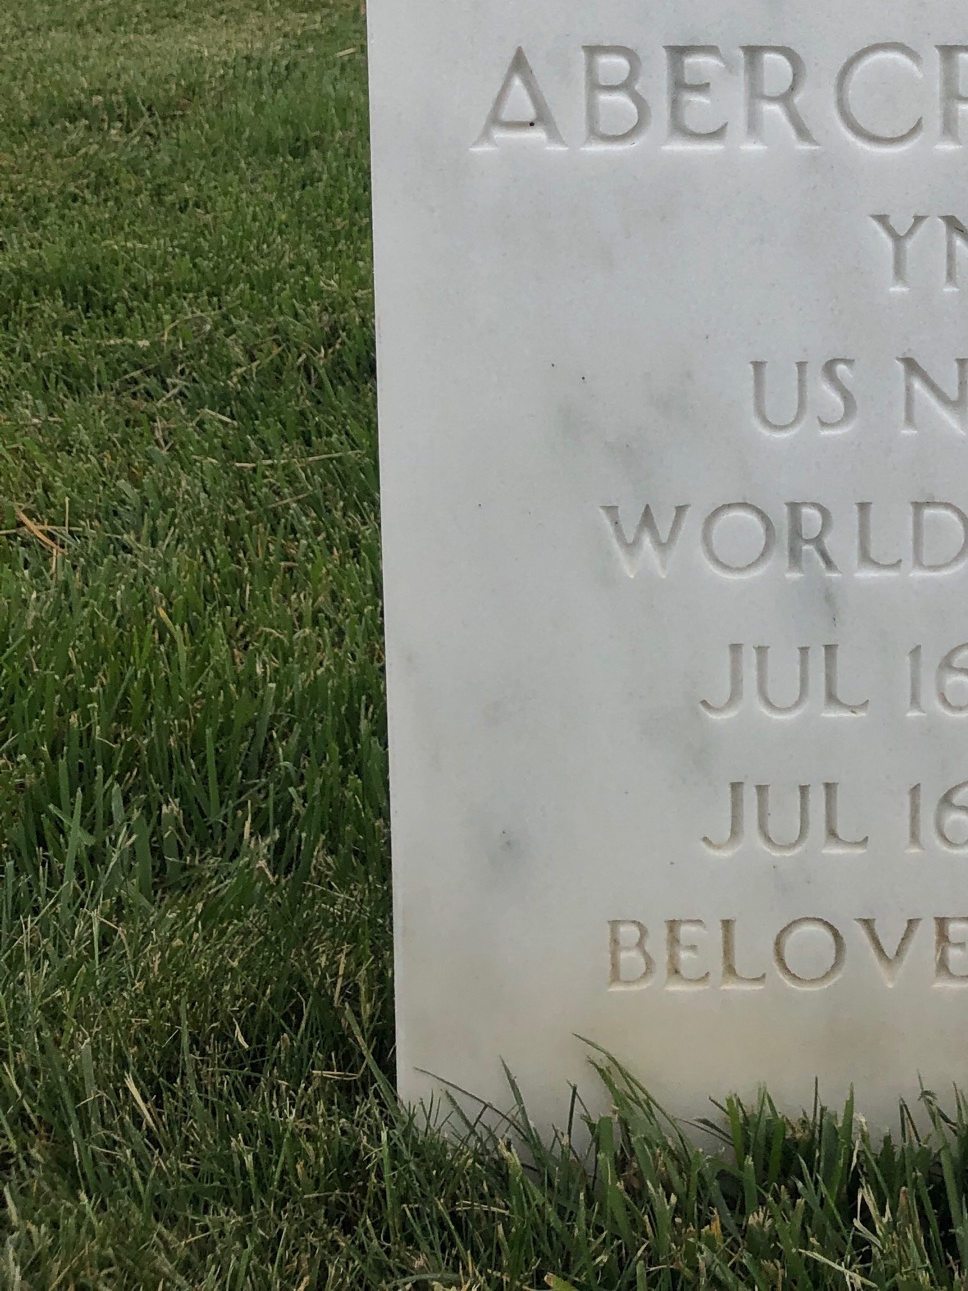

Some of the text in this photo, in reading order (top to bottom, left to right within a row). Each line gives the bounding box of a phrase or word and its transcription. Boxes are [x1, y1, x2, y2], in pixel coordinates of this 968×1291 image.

[749, 358, 857, 437] US
[699, 642, 870, 720] JUL
[700, 781, 869, 857] JUL
